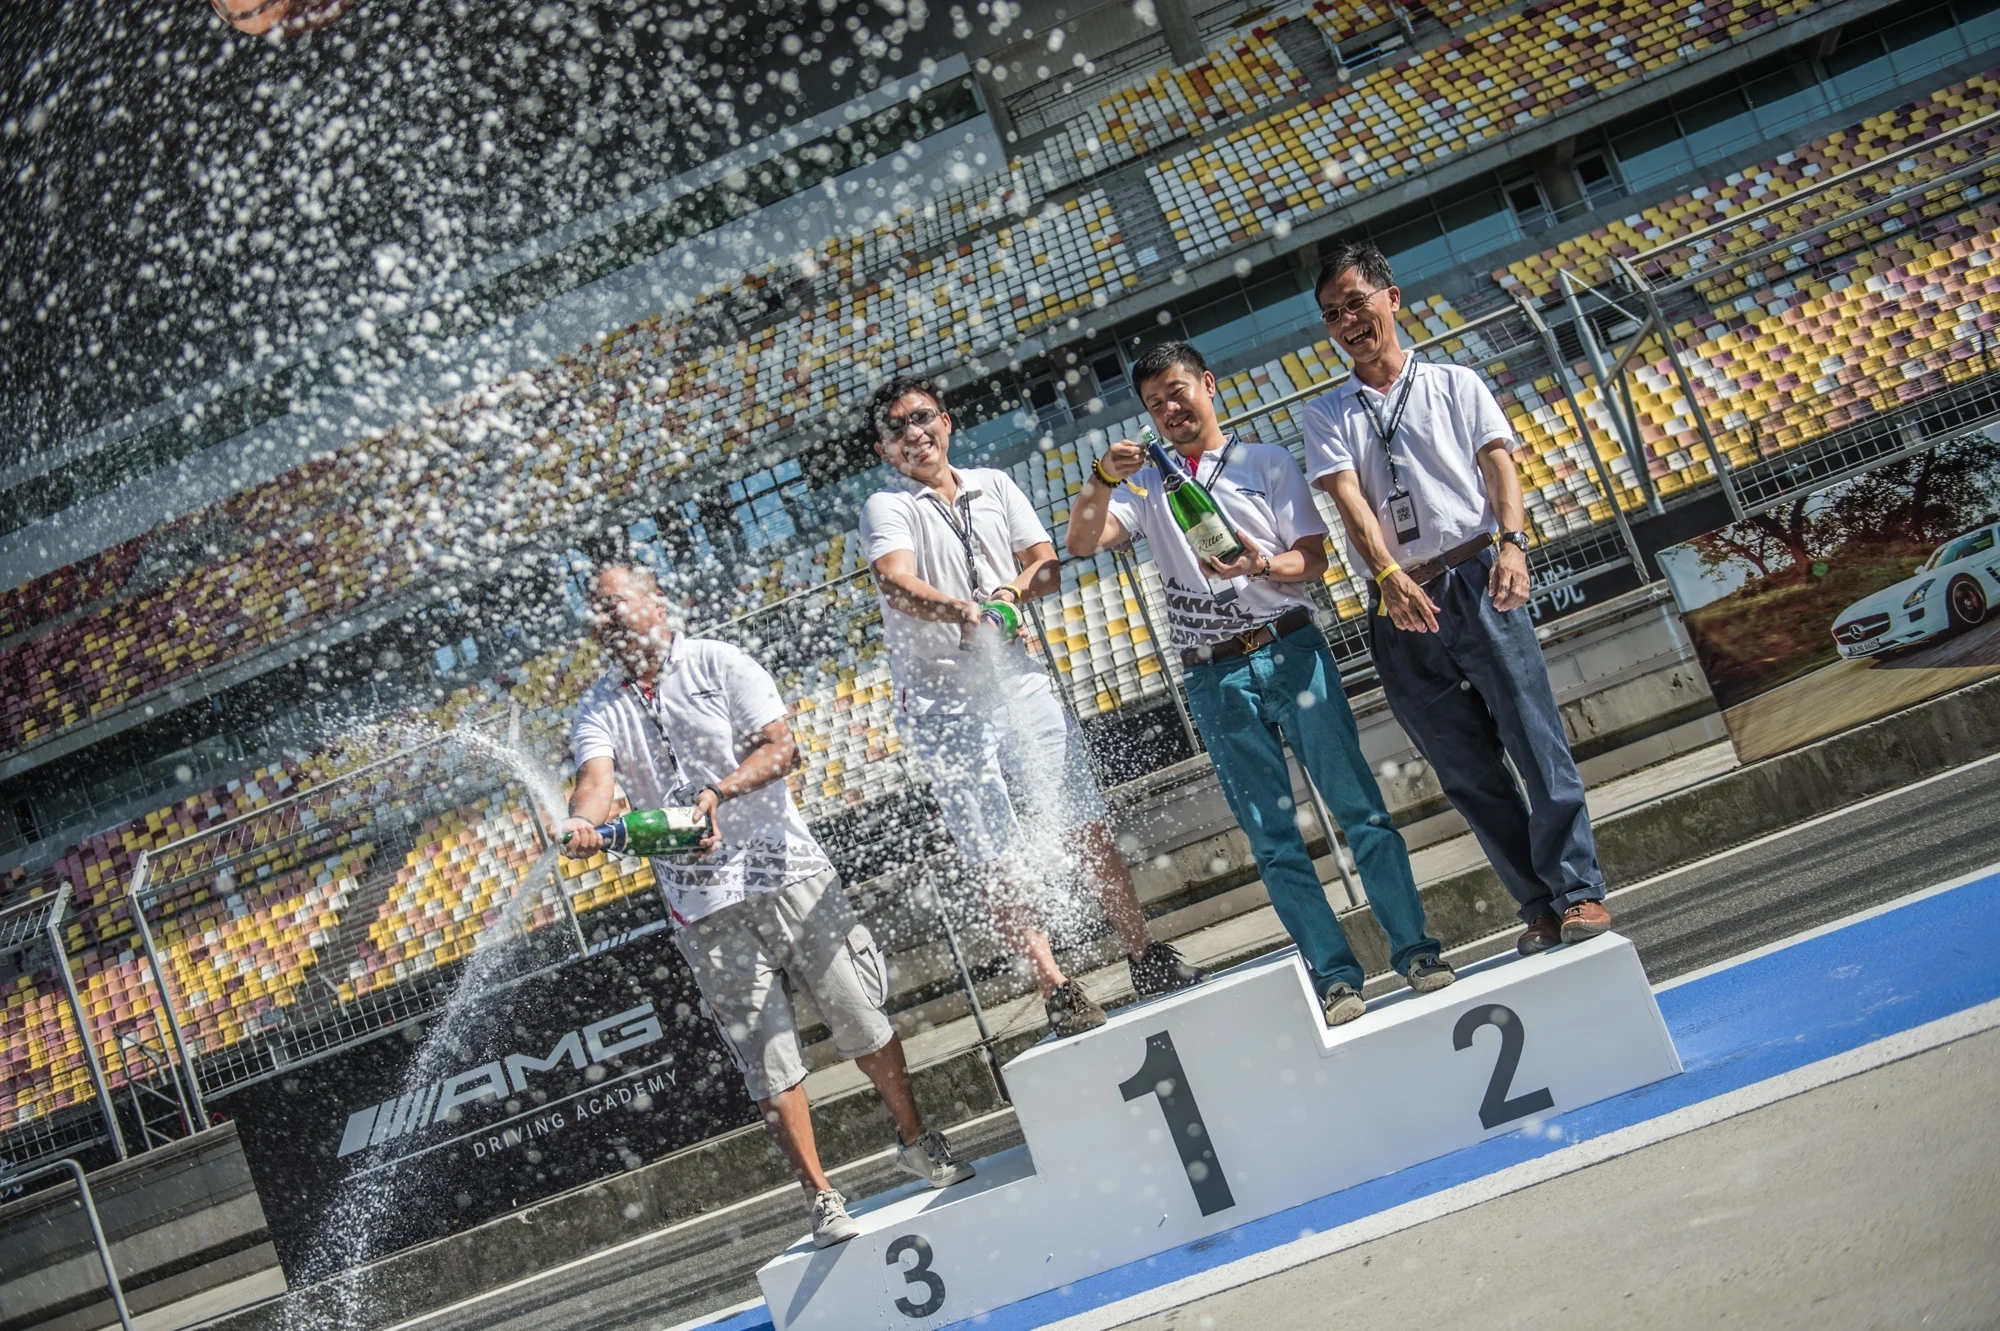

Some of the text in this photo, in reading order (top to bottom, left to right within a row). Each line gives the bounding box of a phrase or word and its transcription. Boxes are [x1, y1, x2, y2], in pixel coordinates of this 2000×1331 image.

[1196, 533, 1224, 552] Ritter
[1452, 1003, 1555, 1131] 2
[473, 1069, 678, 1158] DRIVING ACADEMY
[1118, 1029, 1236, 1217] 1
[885, 1234, 946, 1319] 3
